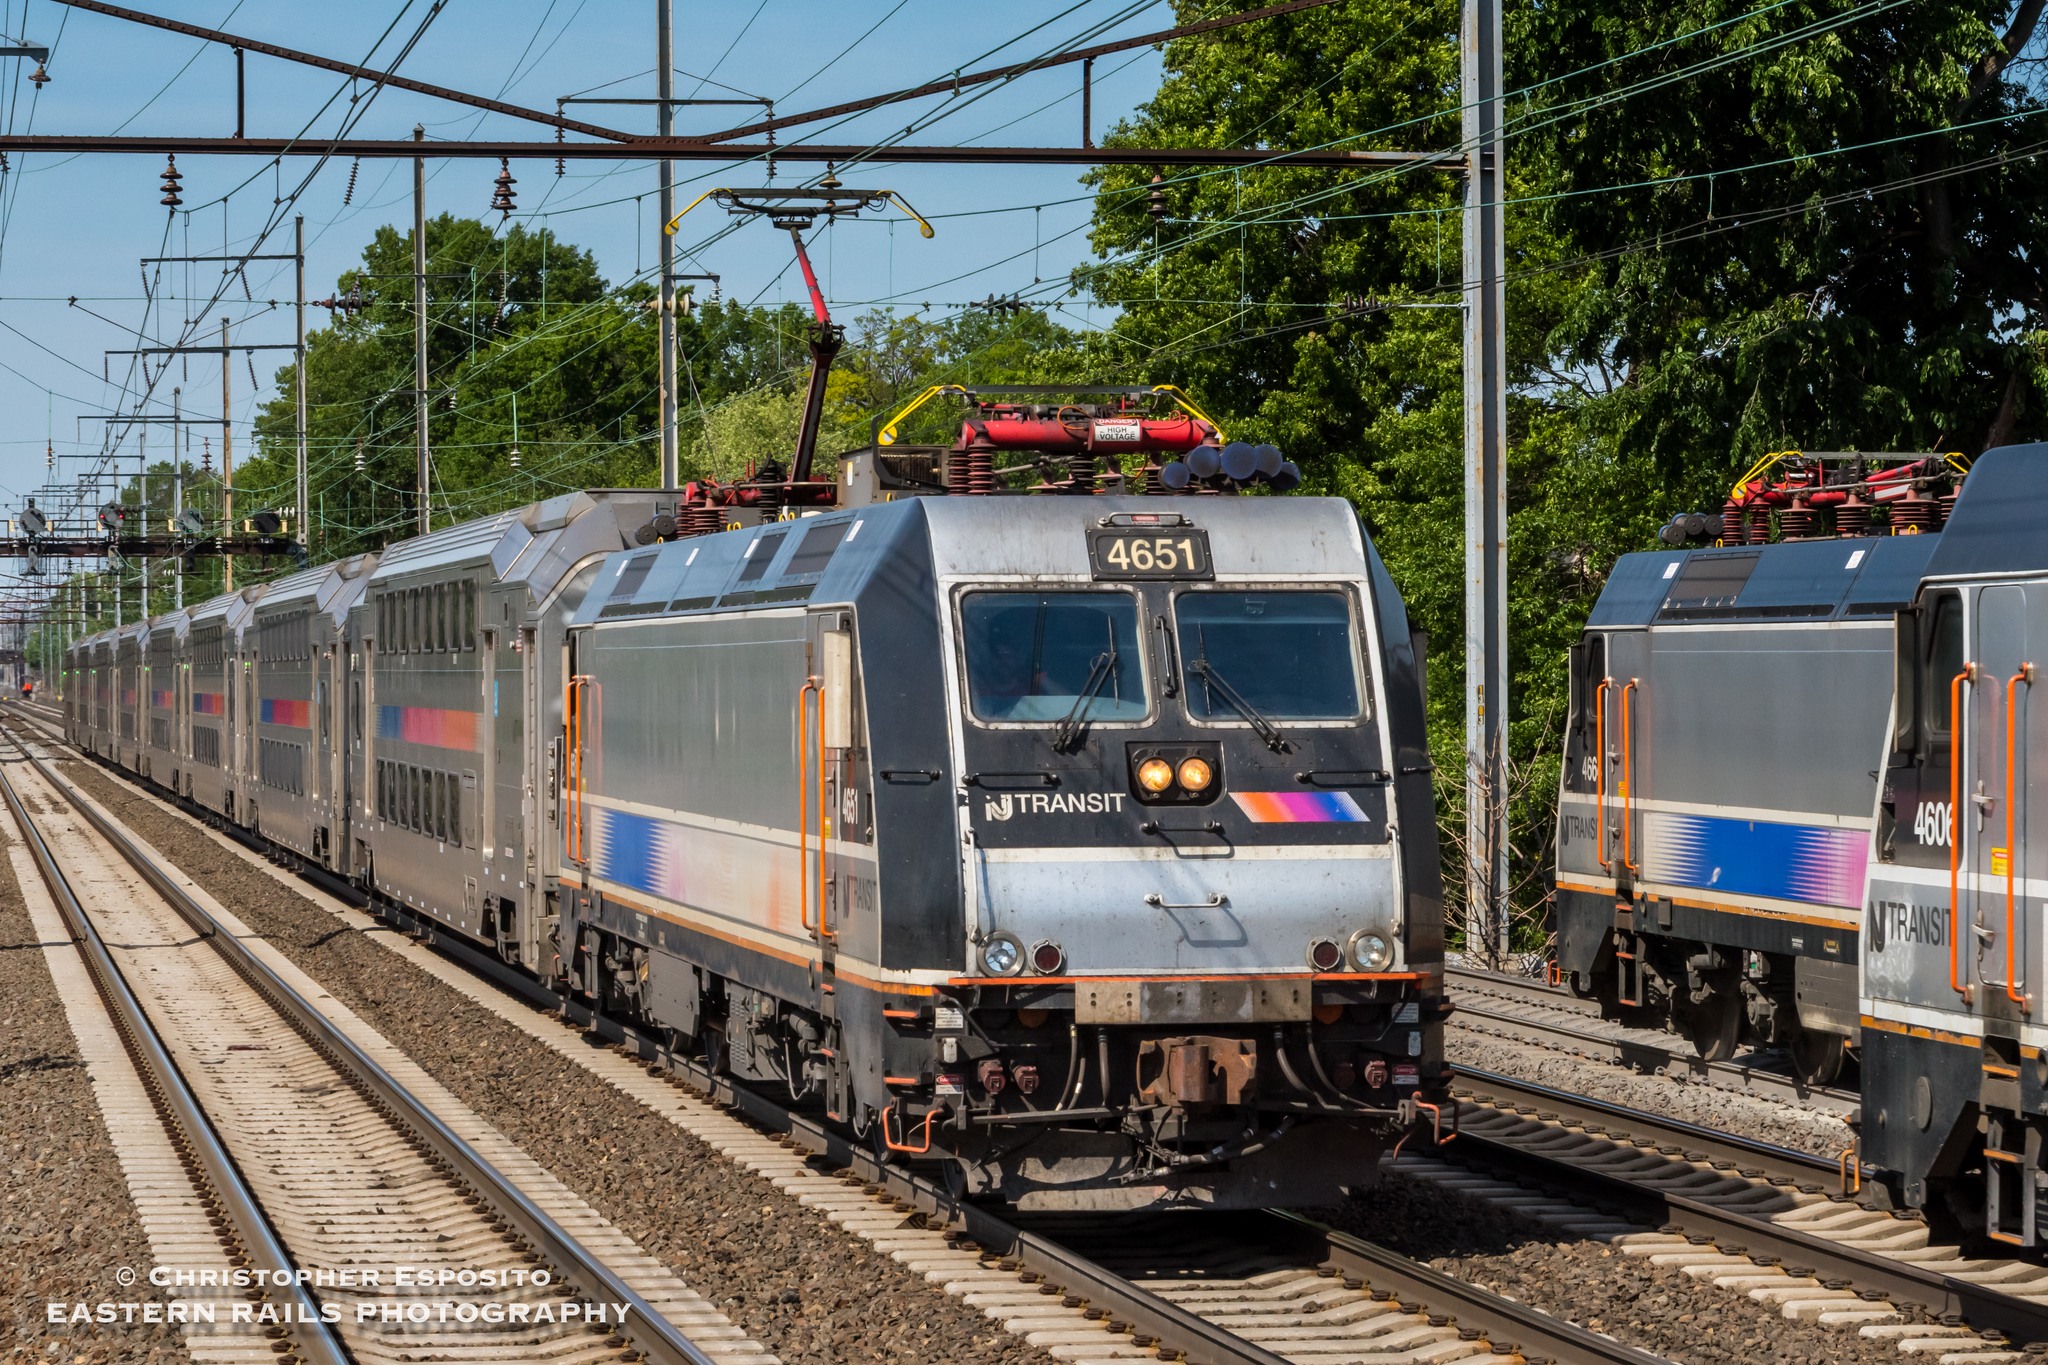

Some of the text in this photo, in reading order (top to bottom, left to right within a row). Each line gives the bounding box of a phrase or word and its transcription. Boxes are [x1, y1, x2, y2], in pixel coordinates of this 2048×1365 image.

[1099, 433, 1136, 441] VOLTAGE
[1107, 426, 1127, 434] HIGH
[1107, 538, 1195, 570] 4651
[1582, 755, 1602, 782] 466
[842, 787, 859, 825] 4651
[1014, 792, 1126, 813] TRANSIT
[1913, 801, 1952, 847] 4606
